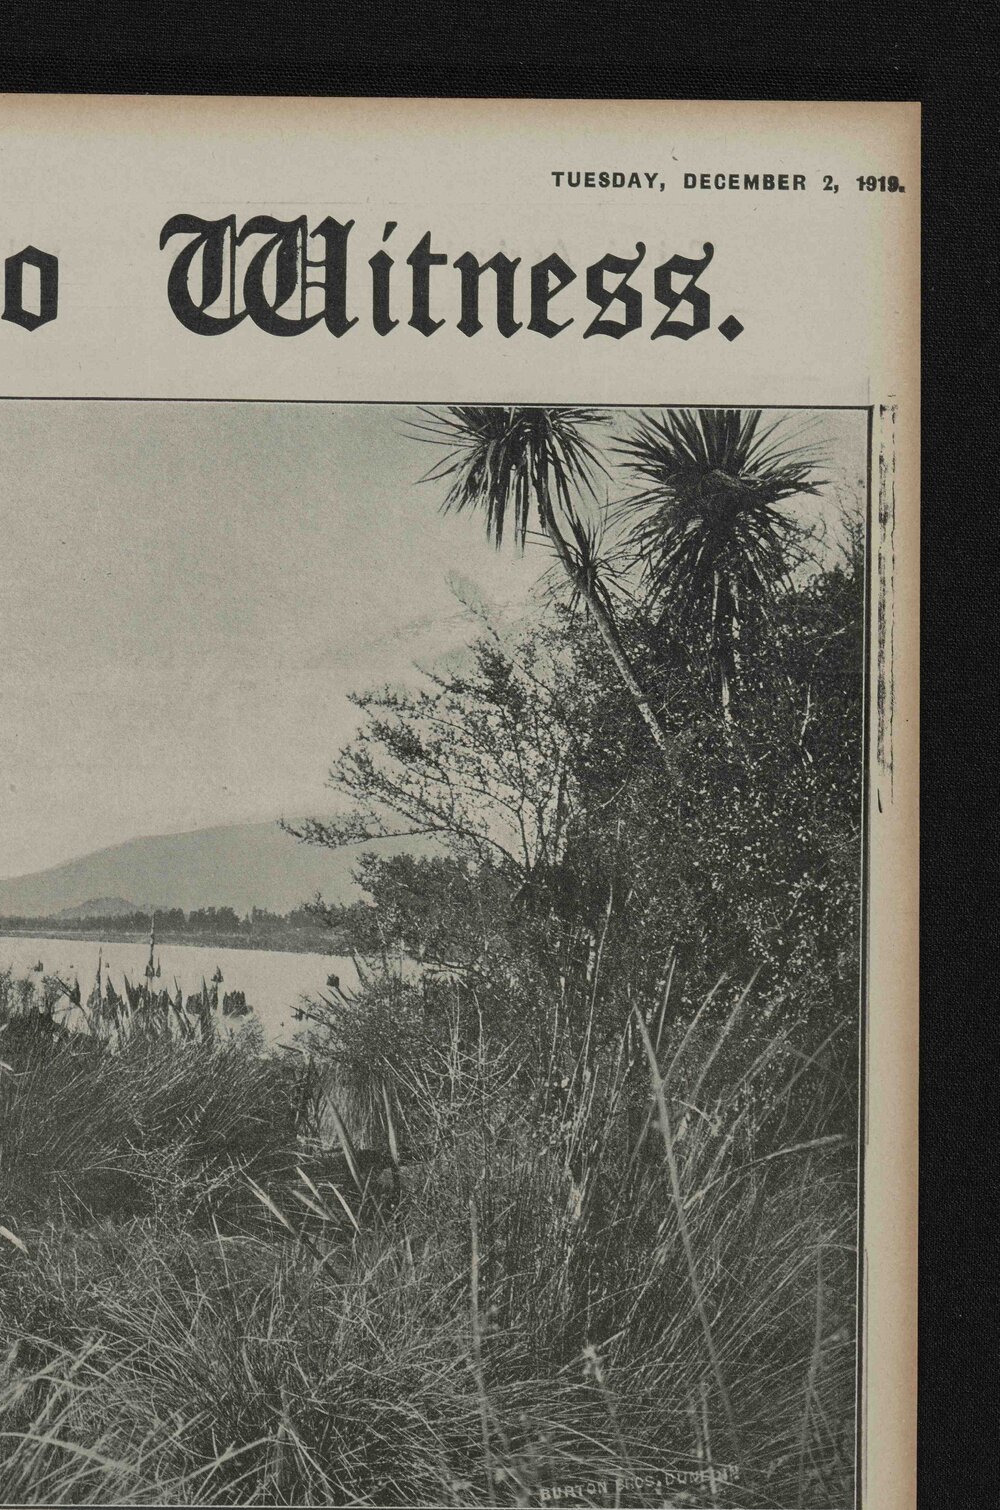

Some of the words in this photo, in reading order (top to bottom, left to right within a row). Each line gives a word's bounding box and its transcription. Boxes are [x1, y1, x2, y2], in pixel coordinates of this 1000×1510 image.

[551, 171, 665, 192] TUESDAY,
[683, 173, 806, 191] DECEMBER
[822, 175, 839, 194] 2,
[159, 213, 745, 342] Witness.
[539, 1482, 609, 1502] BURTON
